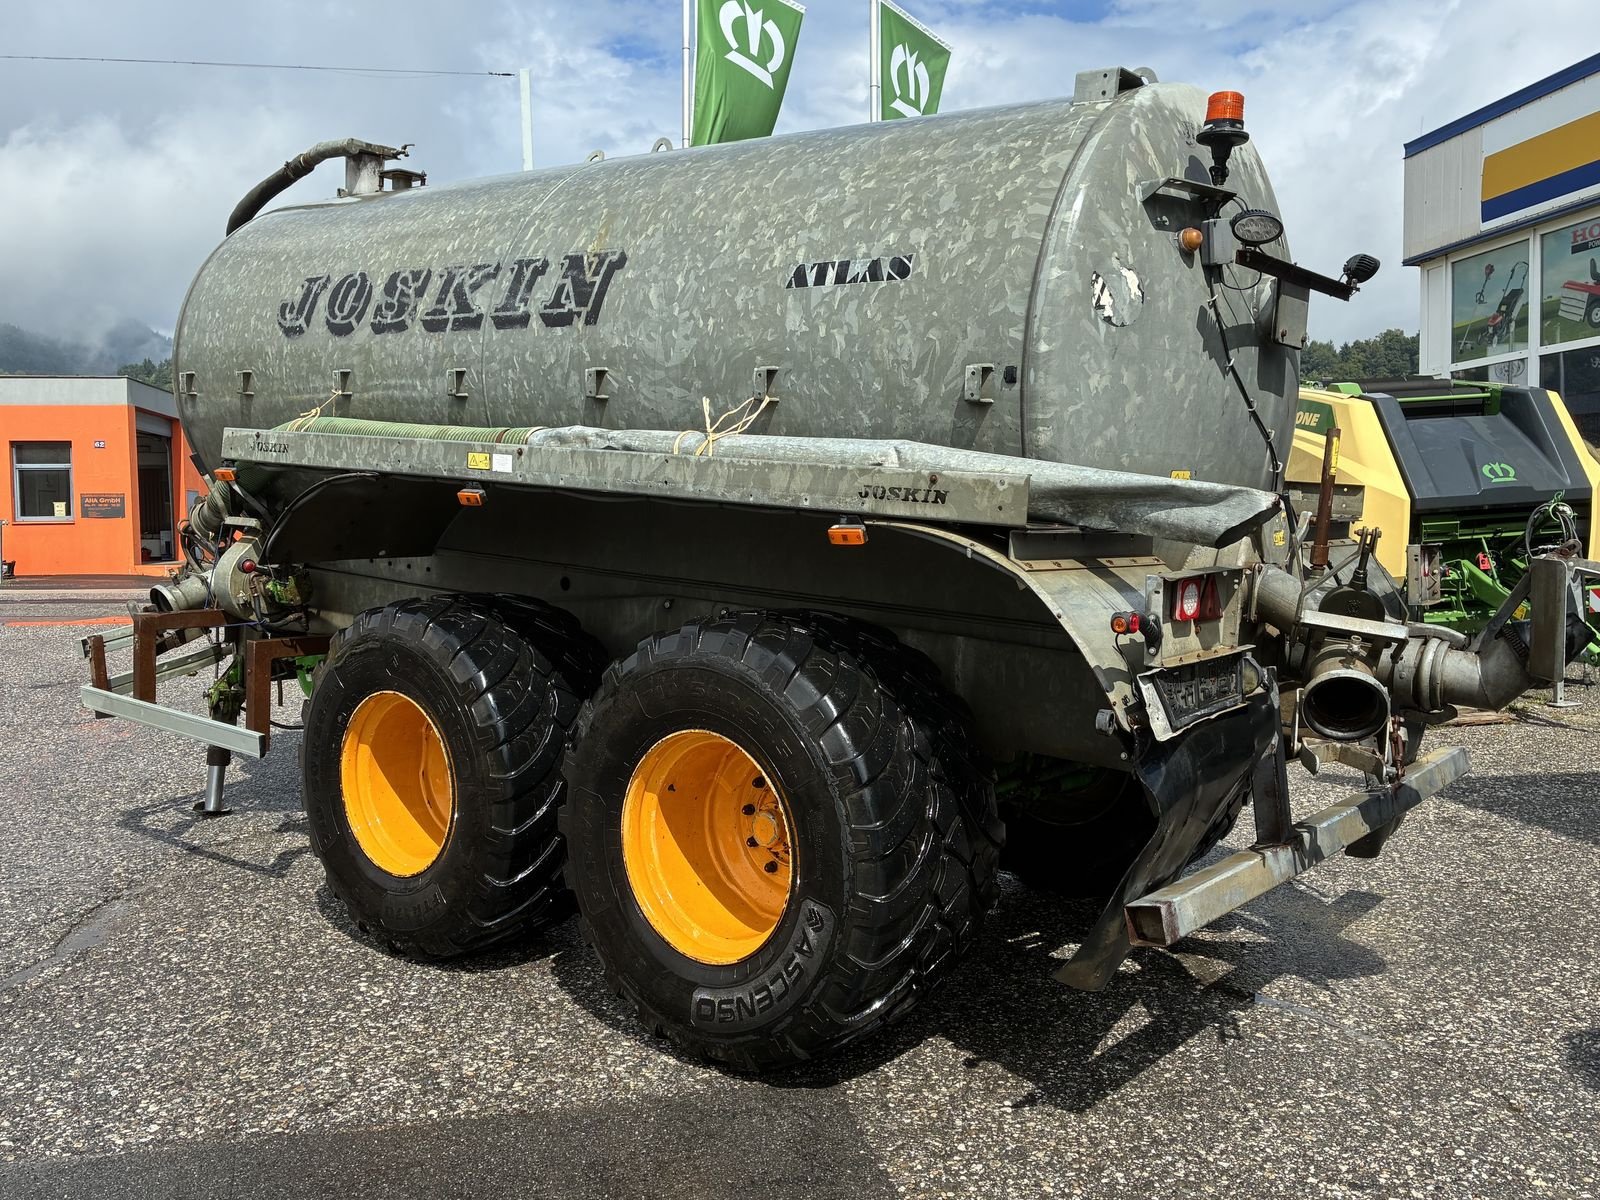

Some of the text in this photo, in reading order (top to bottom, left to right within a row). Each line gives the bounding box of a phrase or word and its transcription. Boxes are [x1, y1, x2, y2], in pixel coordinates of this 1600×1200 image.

[785, 253, 916, 289] ATLAS
[277, 249, 627, 337] JOSKIN
[251, 441, 289, 453] JOSKIN
[858, 484, 950, 504] JOSKIN
[696, 928, 815, 1023] ASCENSO
